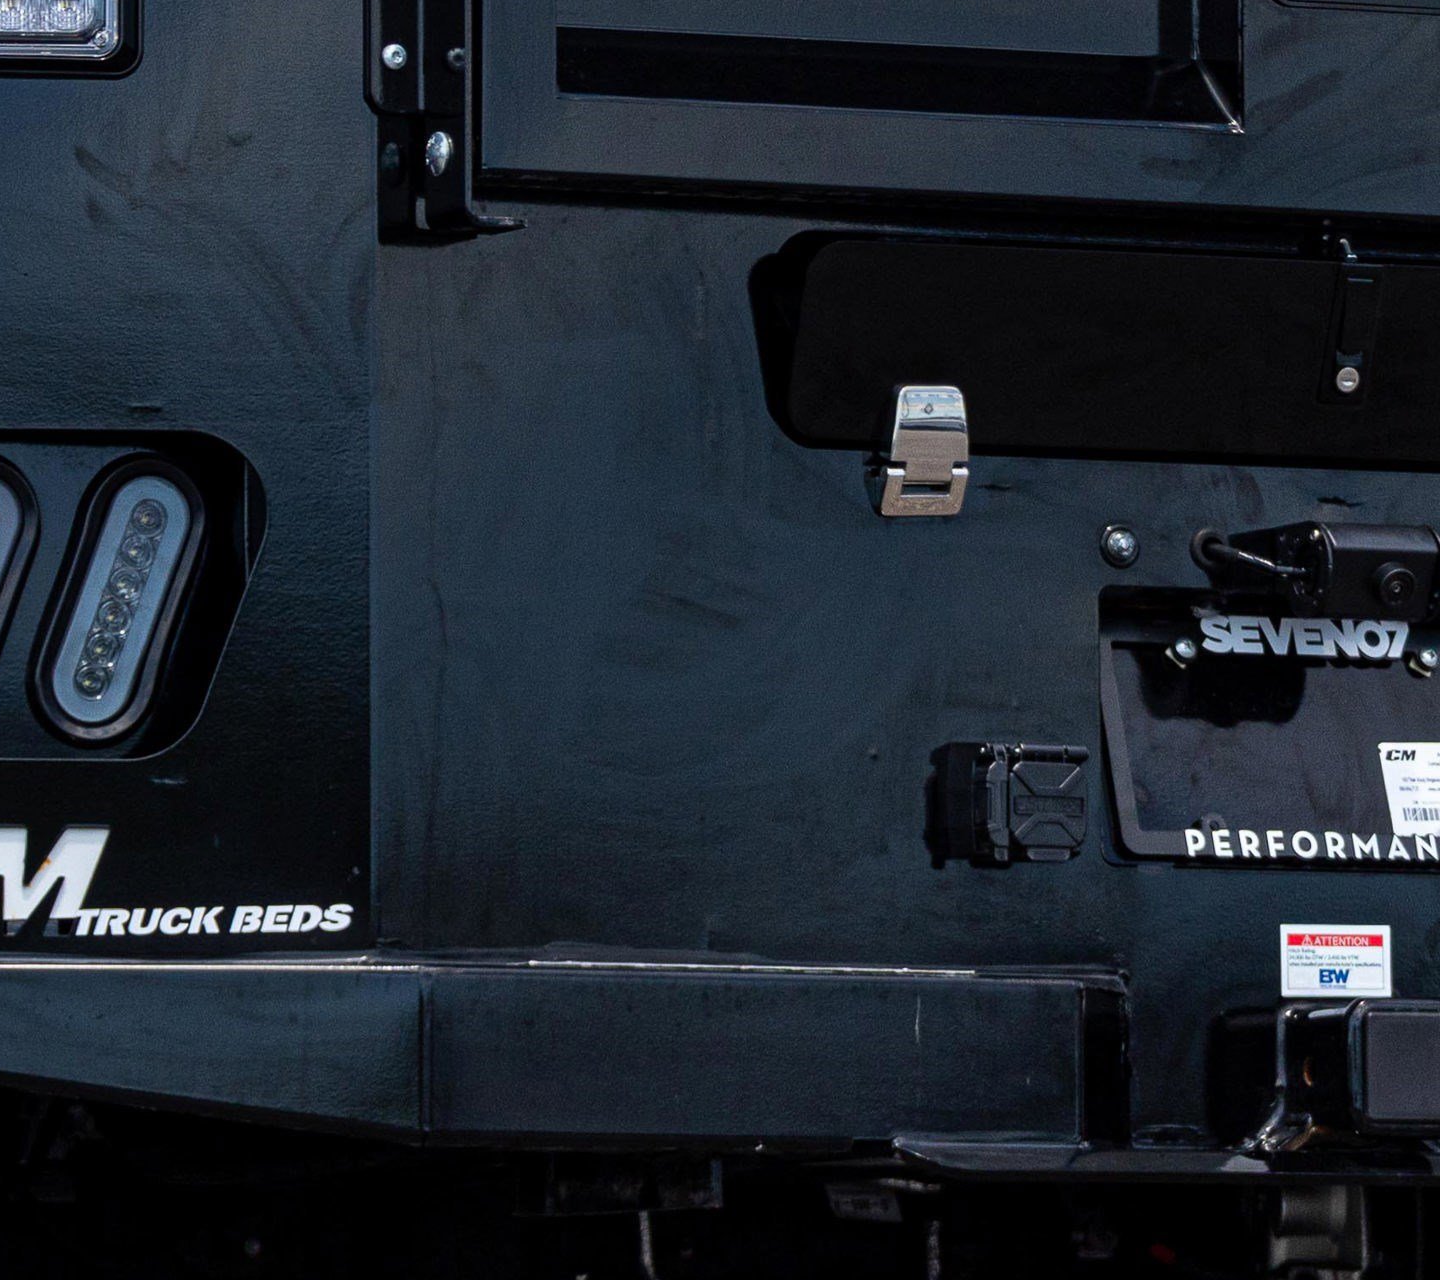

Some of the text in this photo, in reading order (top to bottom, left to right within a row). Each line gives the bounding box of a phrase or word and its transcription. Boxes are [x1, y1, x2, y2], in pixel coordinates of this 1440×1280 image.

[1385, 749, 1417, 761] CM
[74, 907, 220, 937] TRUCK
[228, 903, 354, 935] BEDS
[1314, 936, 1369, 947] ATTENTION
